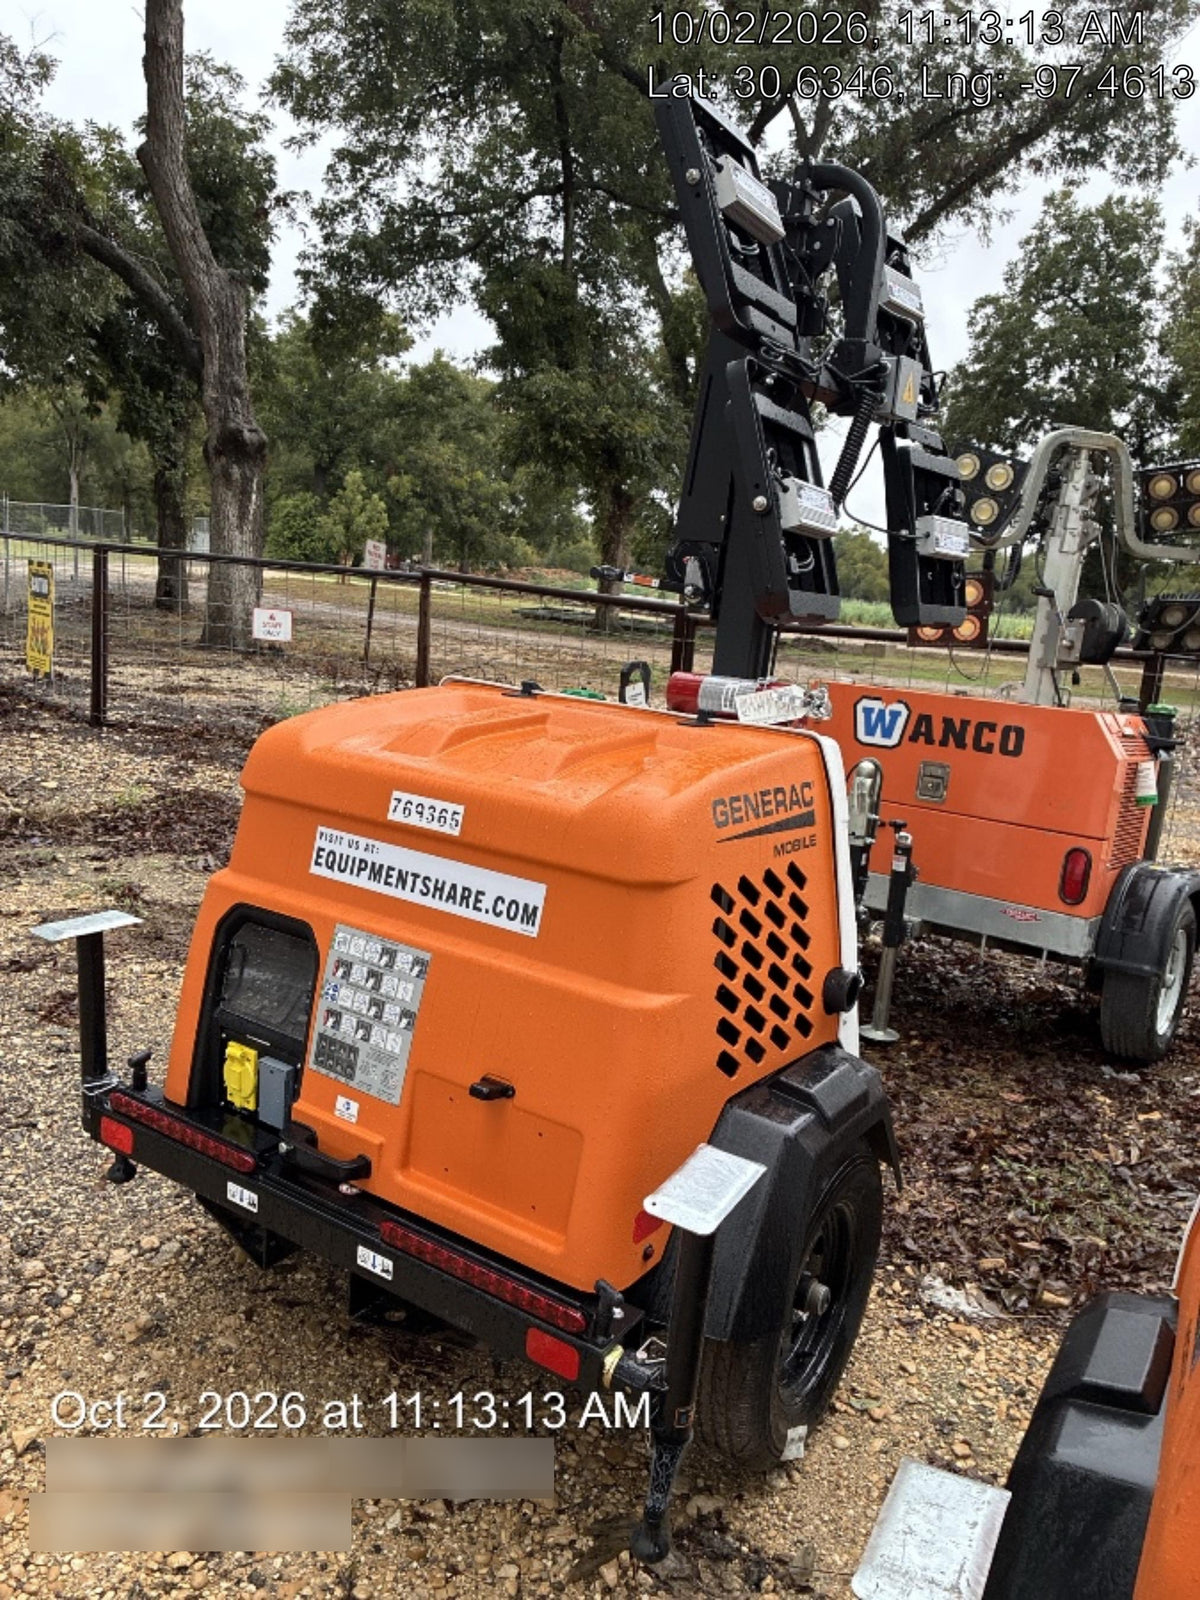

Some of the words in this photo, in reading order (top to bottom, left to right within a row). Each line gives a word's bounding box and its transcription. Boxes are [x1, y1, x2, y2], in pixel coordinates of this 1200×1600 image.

[854, 696, 1025, 757] WANCO
[391, 797, 460, 831] 769365
[711, 781, 815, 828] GENERAC
[319, 830, 344, 846] VISIT
[347, 838, 360, 851] US
[363, 842, 380, 854] AT:
[772, 833, 817, 858] MOBILE
[313, 846, 539, 928] EQUIPMENTSHARE.COM
